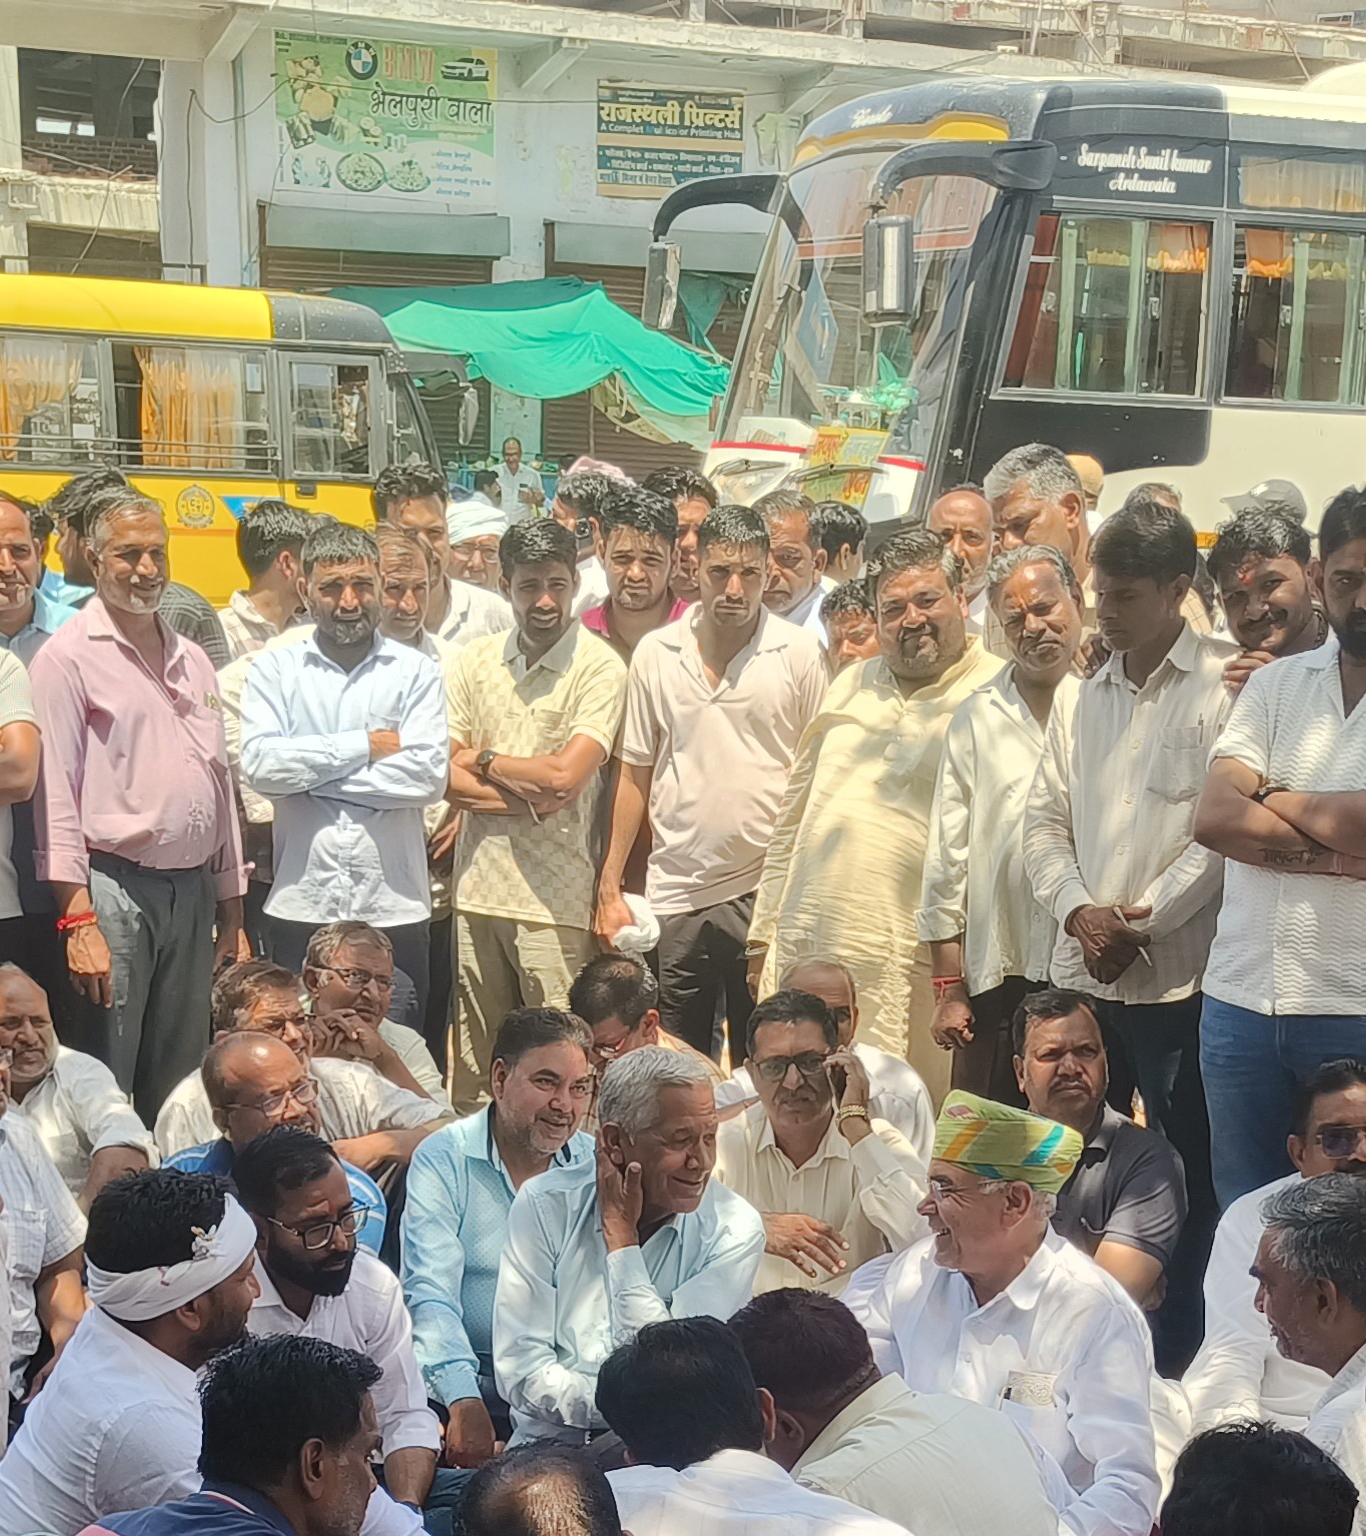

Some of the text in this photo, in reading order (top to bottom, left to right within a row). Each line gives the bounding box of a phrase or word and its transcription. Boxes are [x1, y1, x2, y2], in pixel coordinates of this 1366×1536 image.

[382, 46, 435, 81] BMW
[371, 81, 493, 128] भेलपुरी वाला
[599, 100, 742, 128] राजस्थली प्रिन्टर्स
[690, 127, 723, 139] Printing
[724, 131, 741, 139] Hub
[1137, 146, 1170, 171] Sunil
